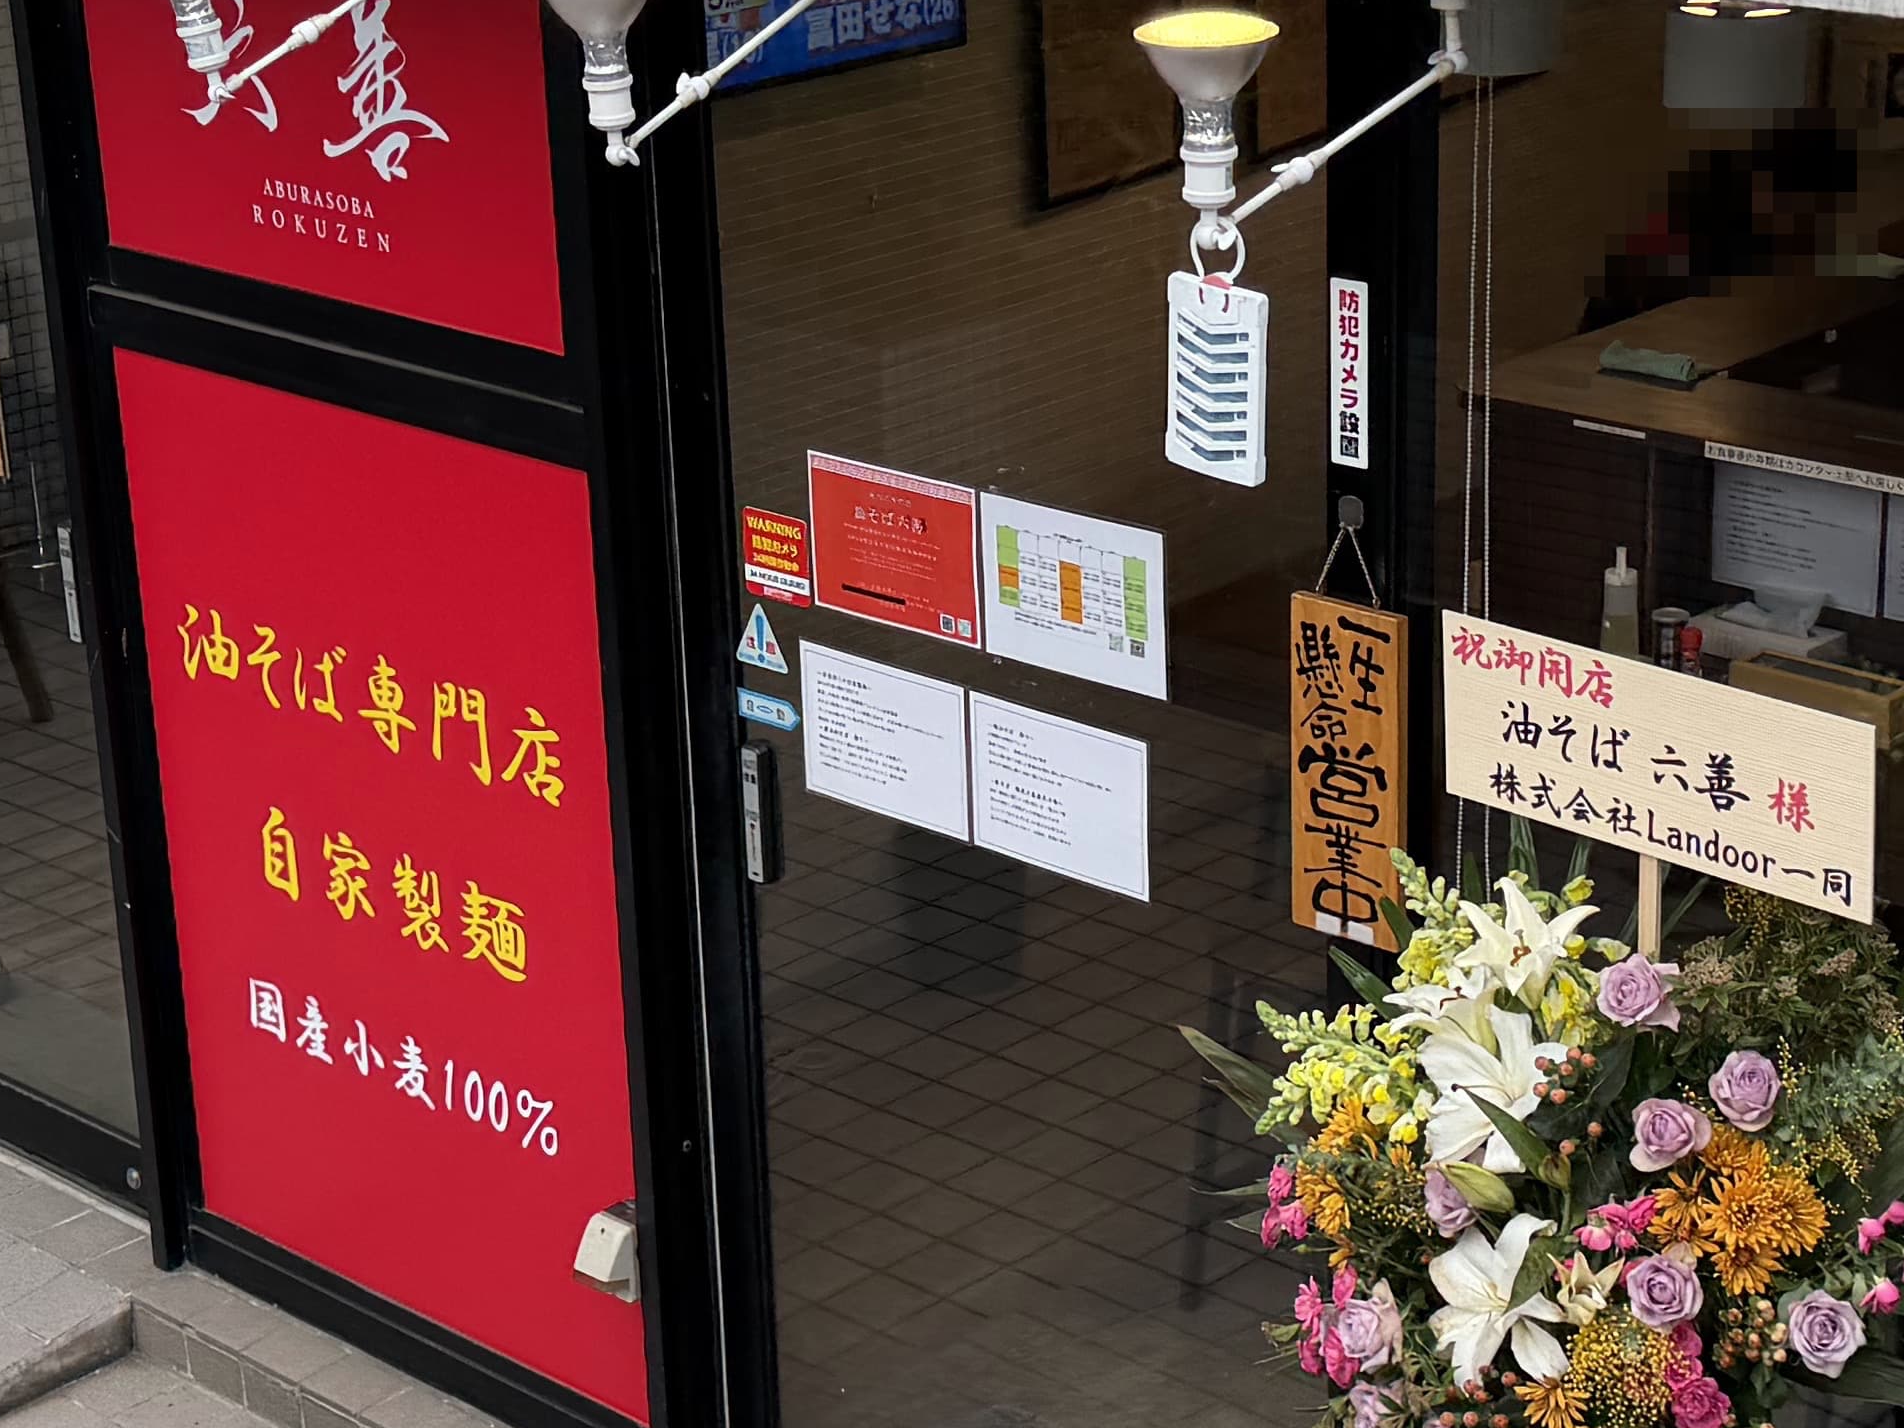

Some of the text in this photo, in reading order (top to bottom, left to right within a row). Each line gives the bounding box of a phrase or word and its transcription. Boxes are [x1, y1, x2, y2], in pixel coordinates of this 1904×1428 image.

[252, 204, 391, 253] ROKUZEN
[263, 178, 375, 219] ABURASOBA
[177, 603, 566, 808] 油そば専門店
[1451, 625, 1616, 709] 祝御開店
[1500, 700, 1631, 773] 油そば
[1650, 744, 1750, 813] 六善
[261, 806, 528, 982] 自家製麺
[1298, 741, 1388, 934] 営業中
[1489, 761, 1853, 908] 株式会社Landoor一同
[249, 977, 559, 1156] 国産小麦100%
